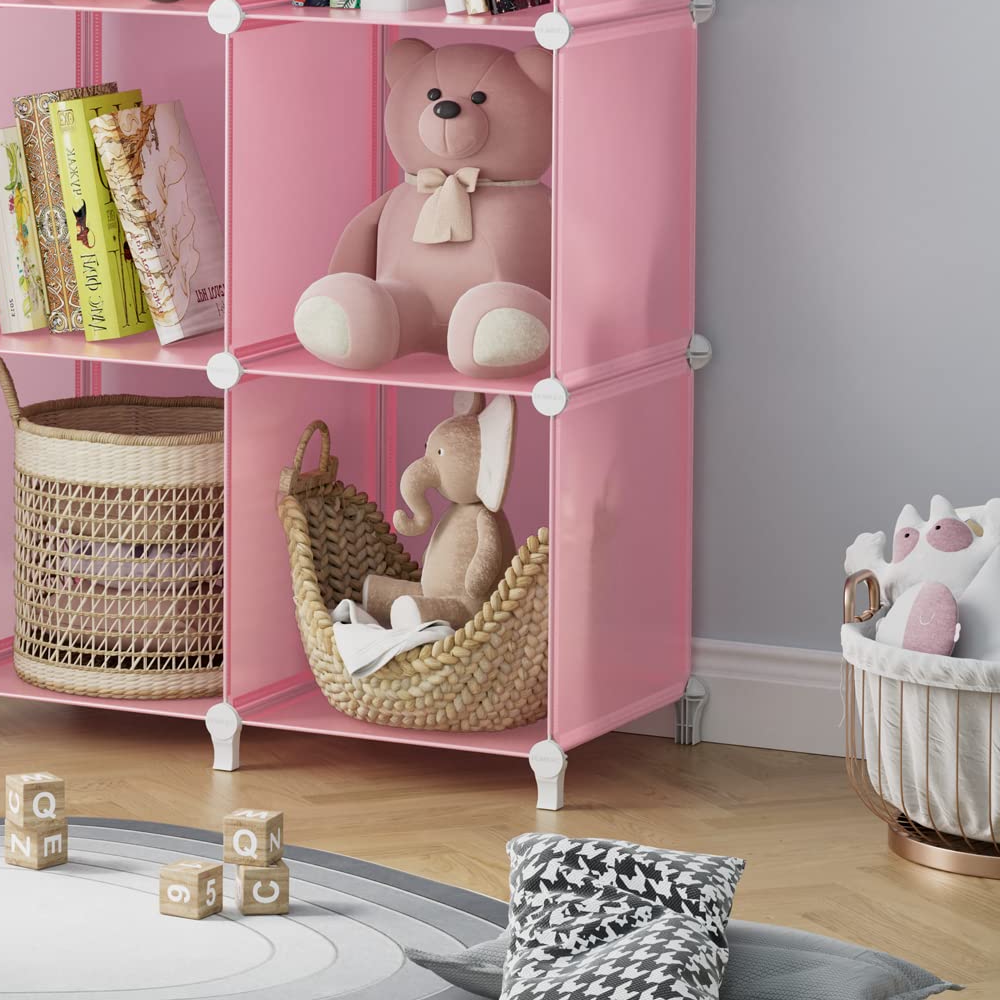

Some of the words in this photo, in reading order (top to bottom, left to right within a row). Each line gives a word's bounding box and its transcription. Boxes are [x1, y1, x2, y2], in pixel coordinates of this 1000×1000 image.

[32, 791, 57, 819] Q
[232, 828, 258, 859] Q
[269, 827, 281, 852] N
[206, 878, 217, 907] 5
